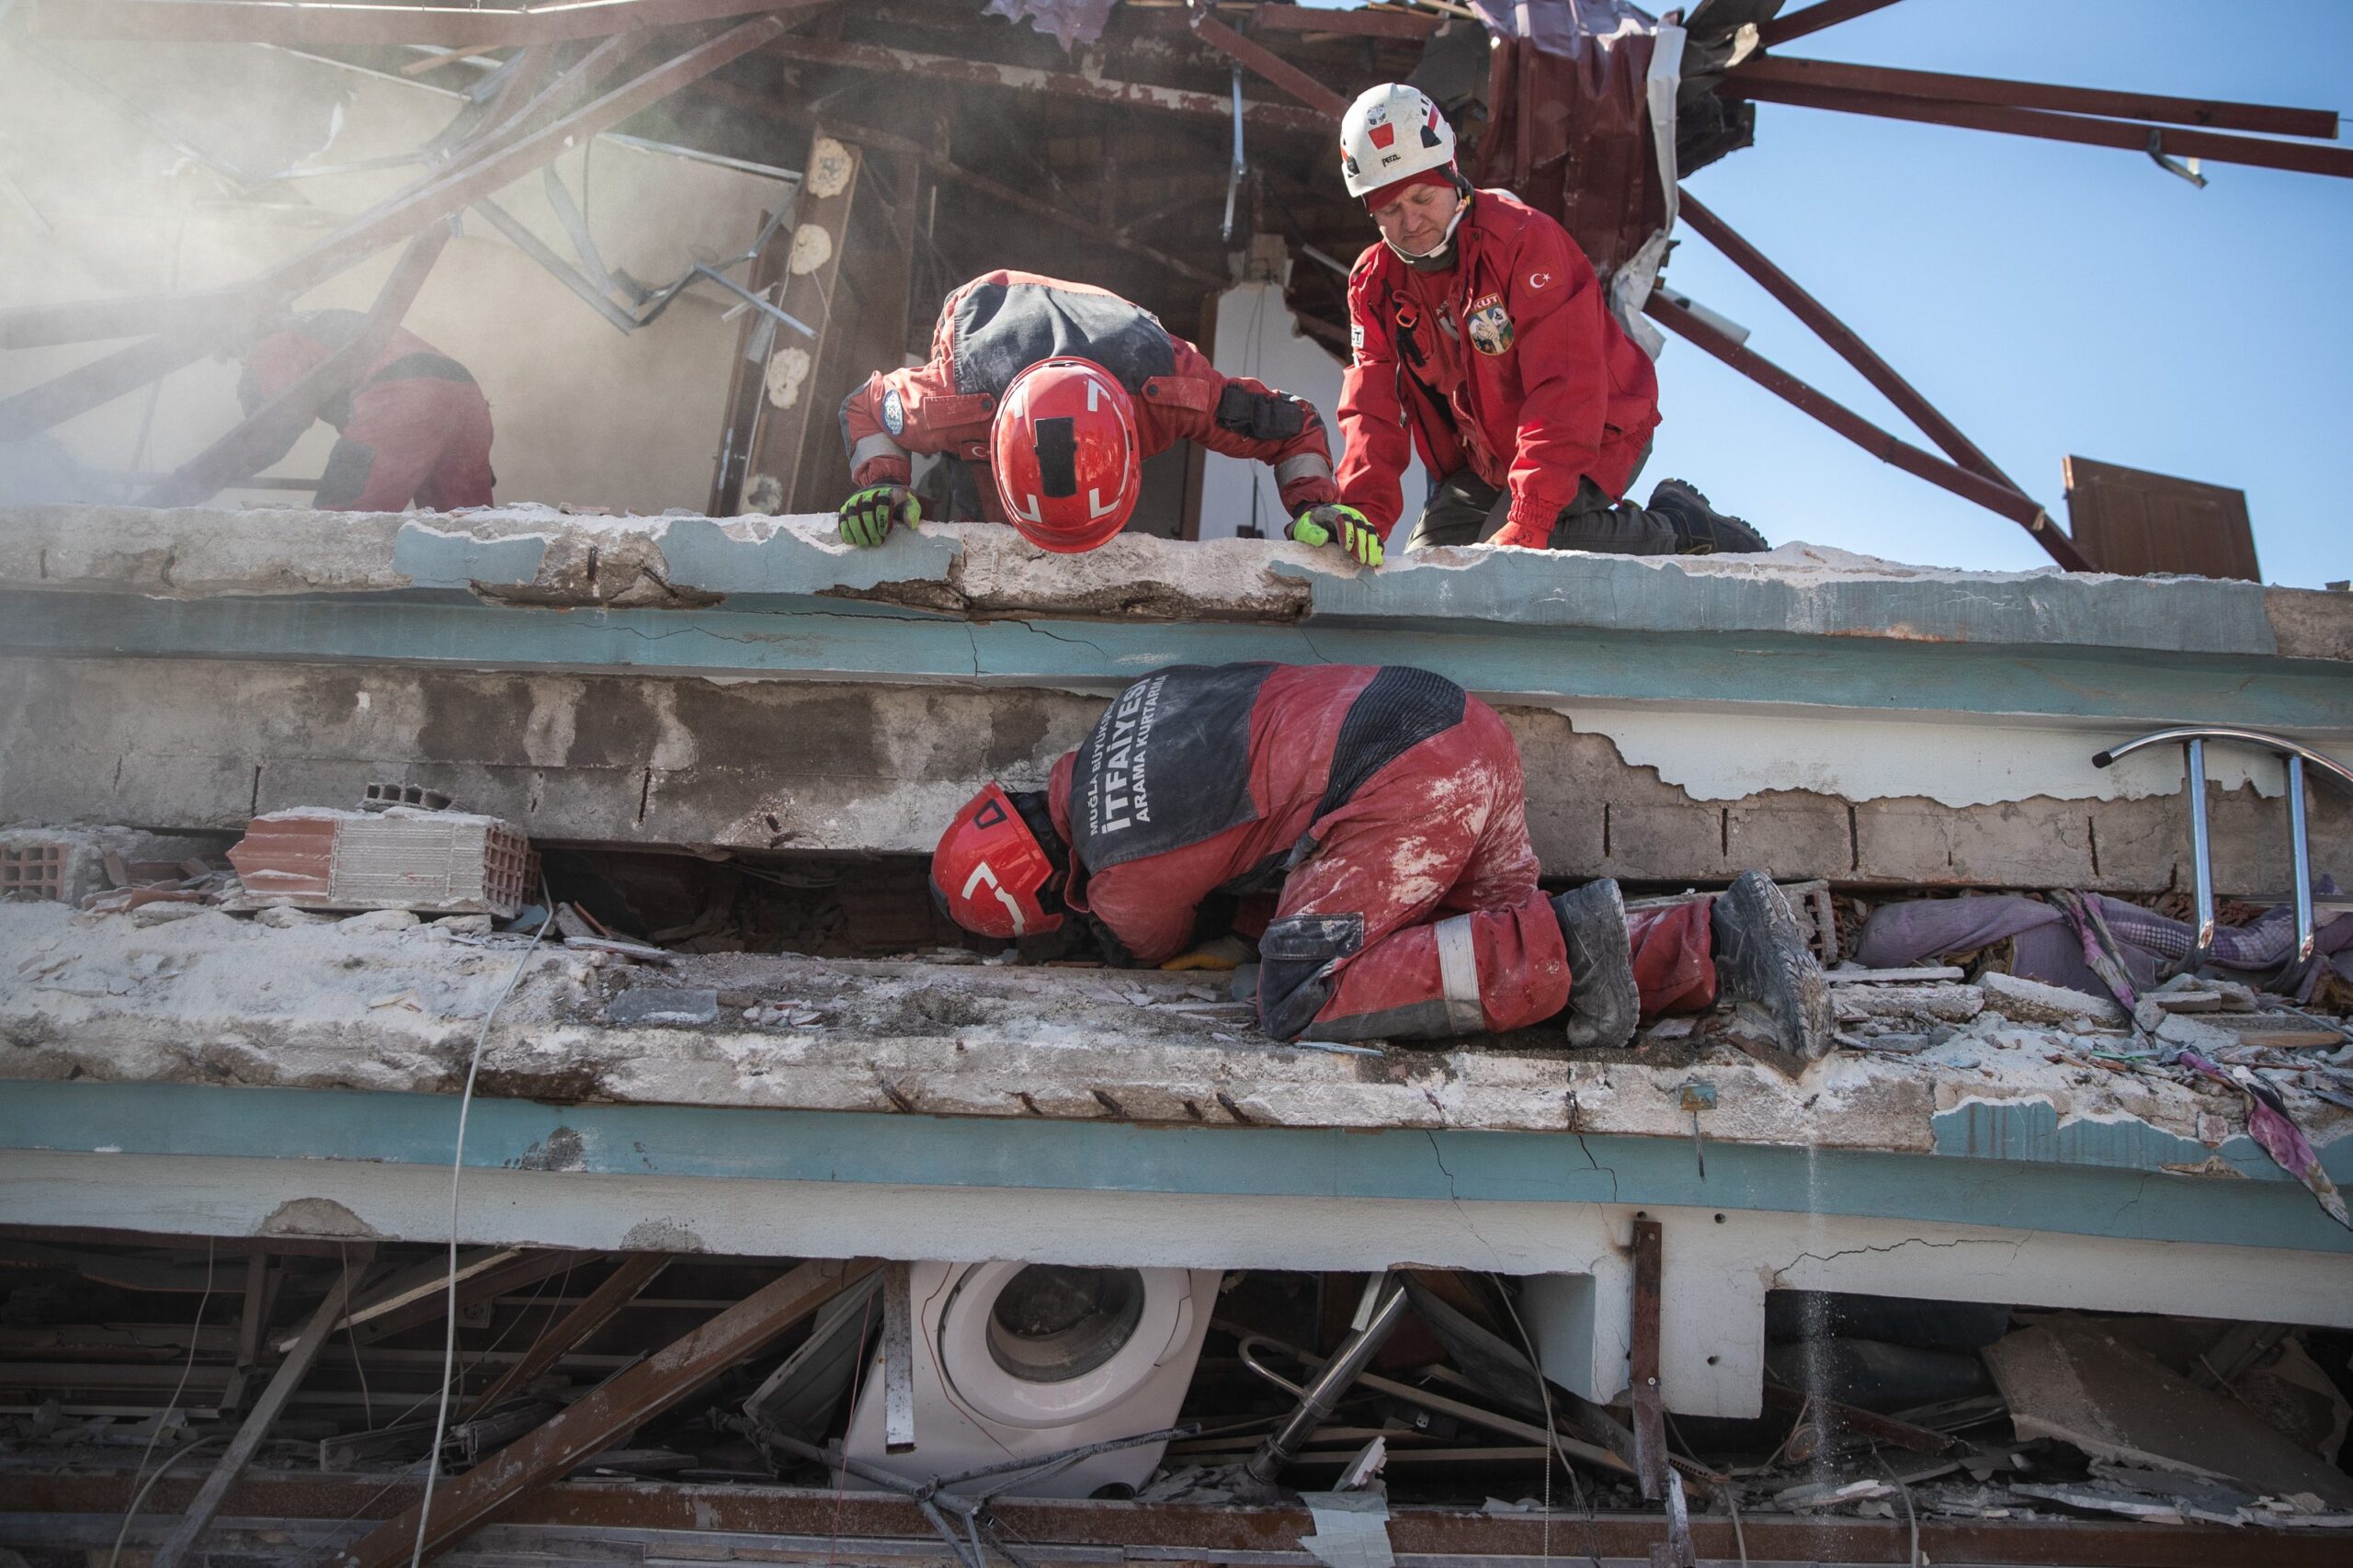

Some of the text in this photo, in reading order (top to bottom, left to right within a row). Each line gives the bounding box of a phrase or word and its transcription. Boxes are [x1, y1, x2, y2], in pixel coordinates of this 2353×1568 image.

[1381, 153, 1402, 167] PETZL
[1473, 295, 1498, 310] KUT
[1132, 674, 1170, 823] ARAMA KURTARMA
[1087, 773, 1099, 836] MUĞLA
